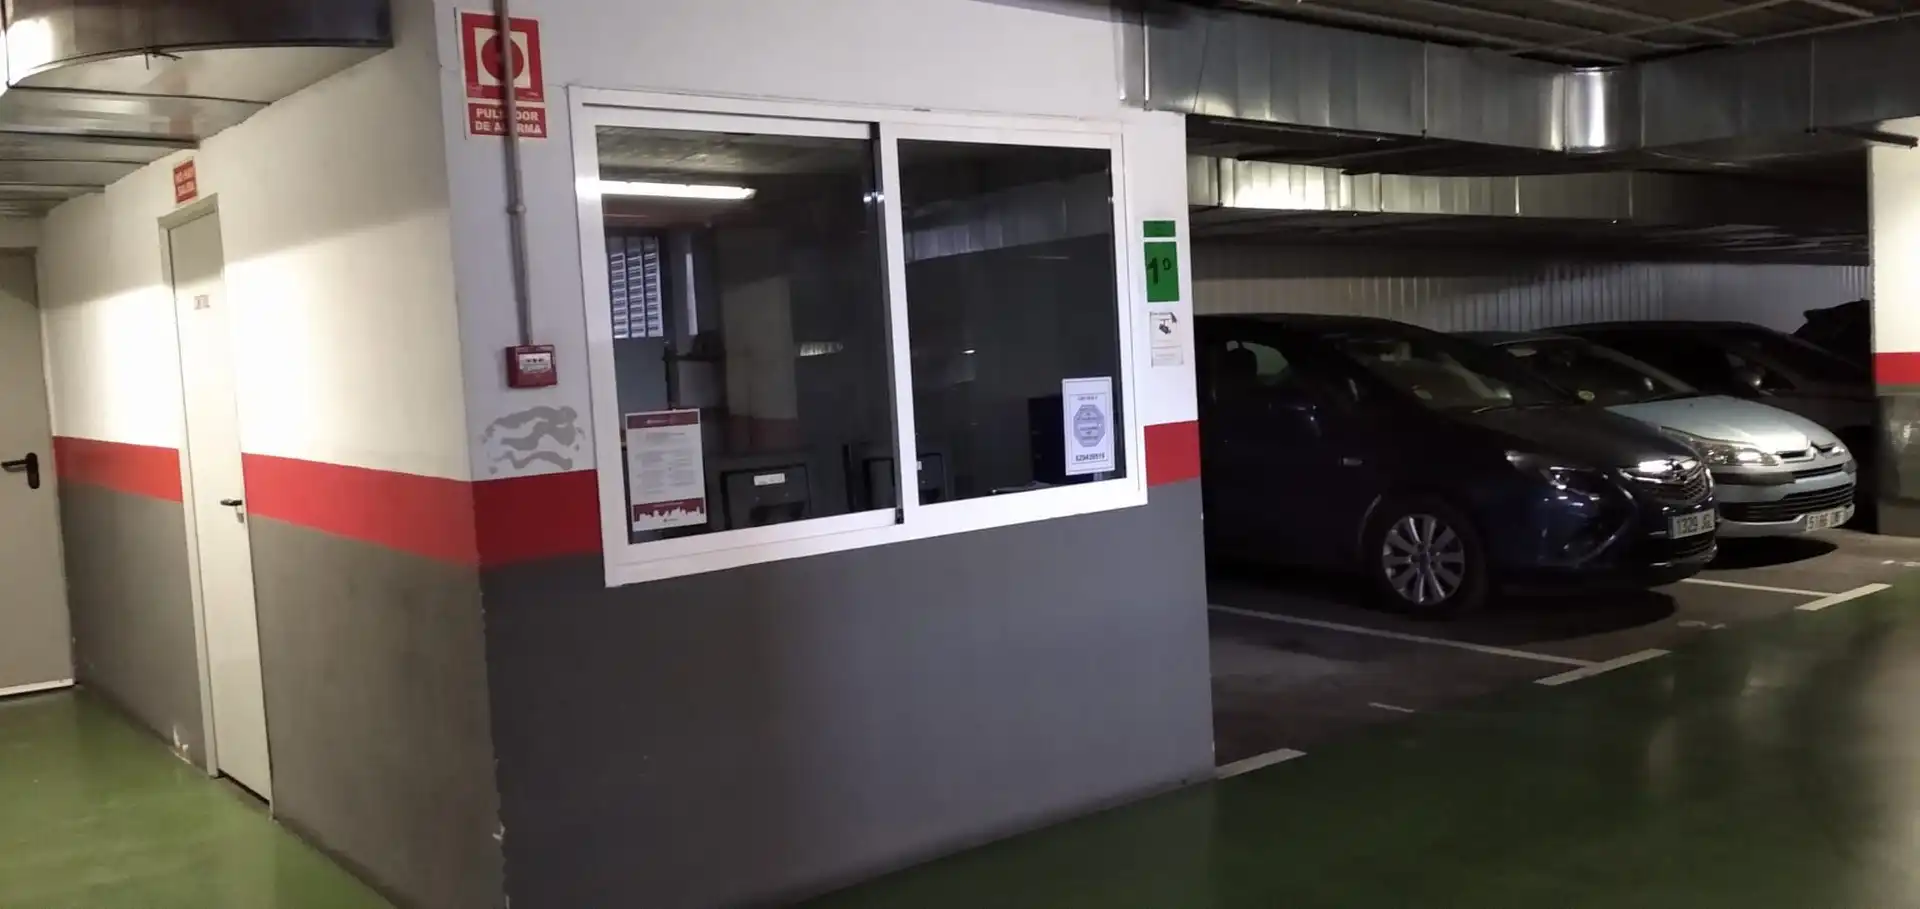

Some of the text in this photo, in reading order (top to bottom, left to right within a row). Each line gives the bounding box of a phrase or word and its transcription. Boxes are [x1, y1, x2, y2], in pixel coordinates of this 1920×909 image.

[476, 107, 539, 121] PULDOR
[475, 120, 542, 134] DE ARMA
